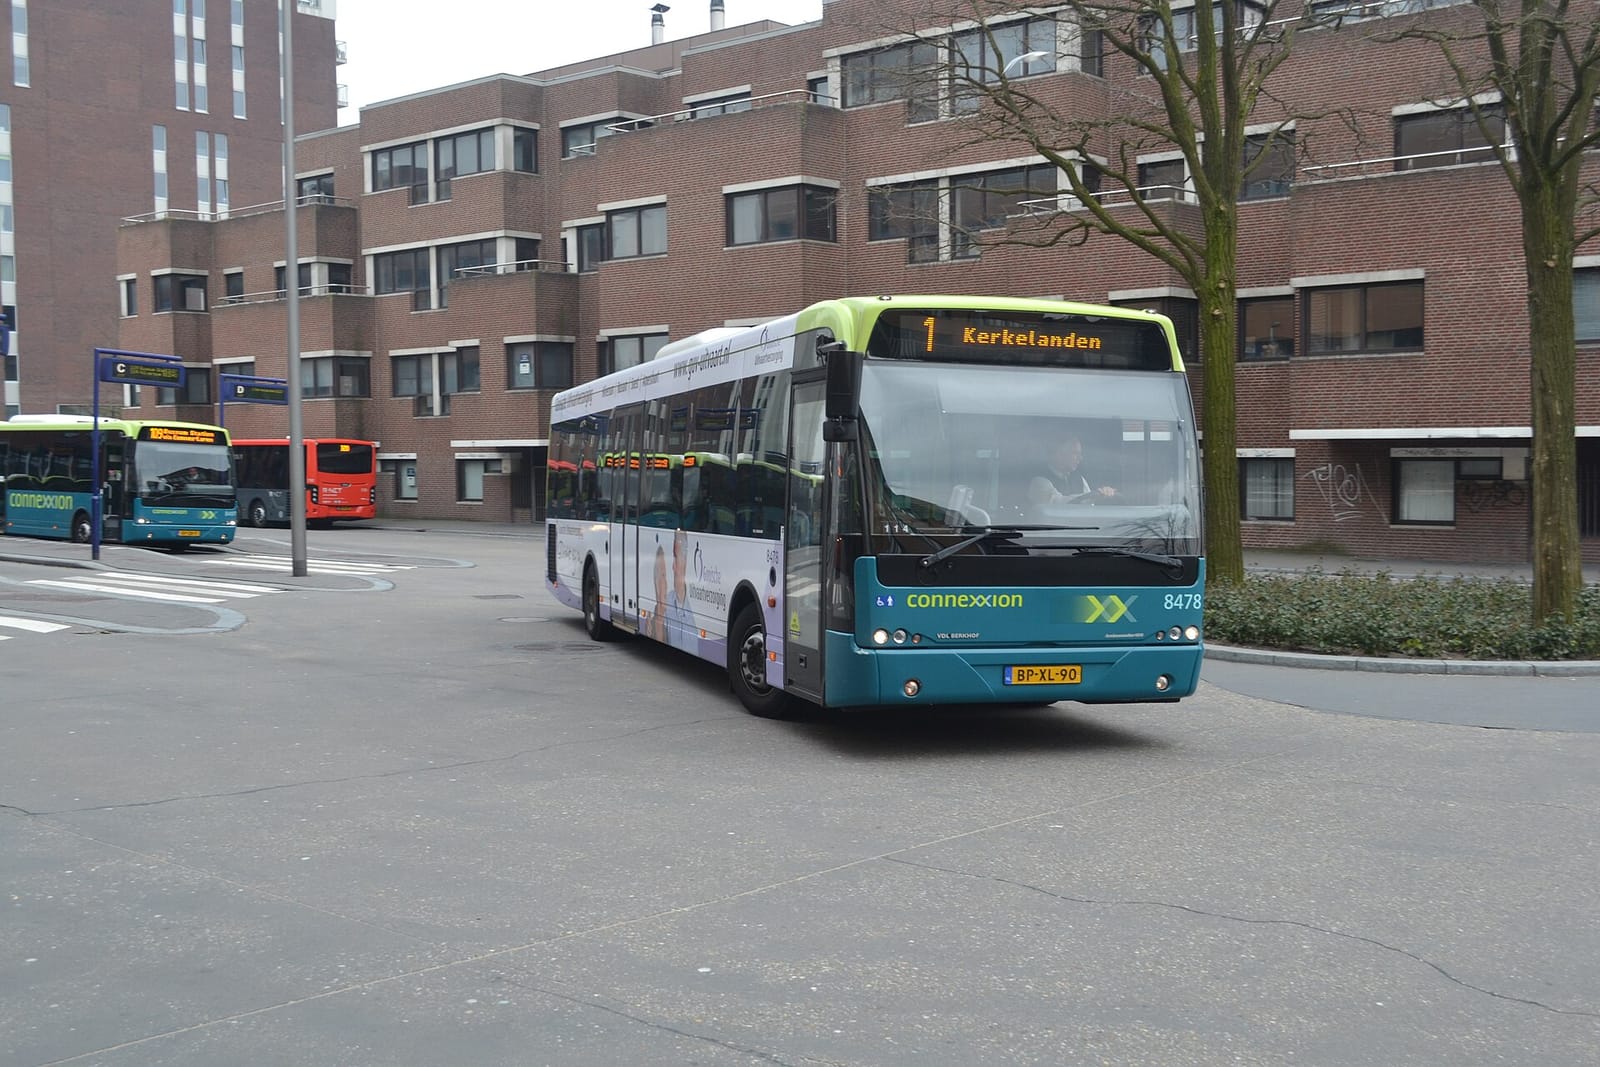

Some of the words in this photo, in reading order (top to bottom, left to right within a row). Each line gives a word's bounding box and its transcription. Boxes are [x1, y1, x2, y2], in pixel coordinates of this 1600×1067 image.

[923, 317, 935, 352] 1
[962, 327, 1101, 349] Kerkelanden
[116, 363, 126, 373] C
[236, 385, 245, 394] D
[9, 492, 74, 510] connexxion
[906, 593, 1023, 608] connexxion
[1163, 593, 1202, 610] 8478
[1017, 668, 1077, 682] BP-XL-90
